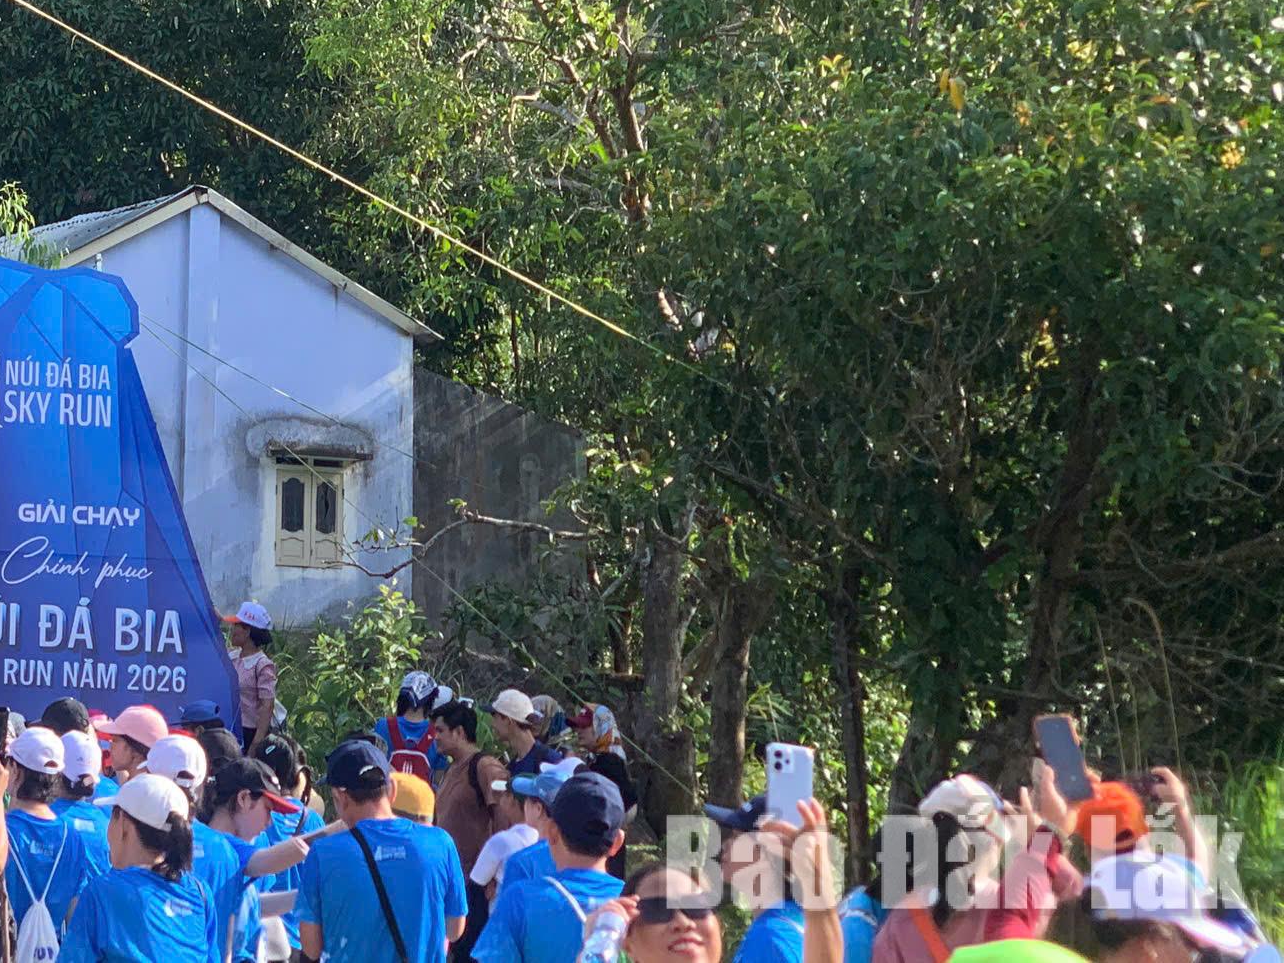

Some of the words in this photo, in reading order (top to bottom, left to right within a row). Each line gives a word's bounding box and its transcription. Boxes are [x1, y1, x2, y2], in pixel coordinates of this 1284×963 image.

[5, 355, 41, 387] NÚI
[46, 357, 73, 388] ĐÁ
[79, 364, 111, 390] BIA
[4, 390, 52, 424] SKY
[59, 393, 112, 428] RUN
[18, 499, 66, 524] GIẢI
[72, 505, 141, 529] CHẠY
[1, 536, 90, 584] Chính
[94, 553, 153, 588] phục
[38, 597, 94, 649] ĐÁ
[115, 607, 183, 653] BIA
[3, 658, 54, 687] RUN
[63, 658, 117, 690] NĂM
[126, 664, 187, 693] 2026
